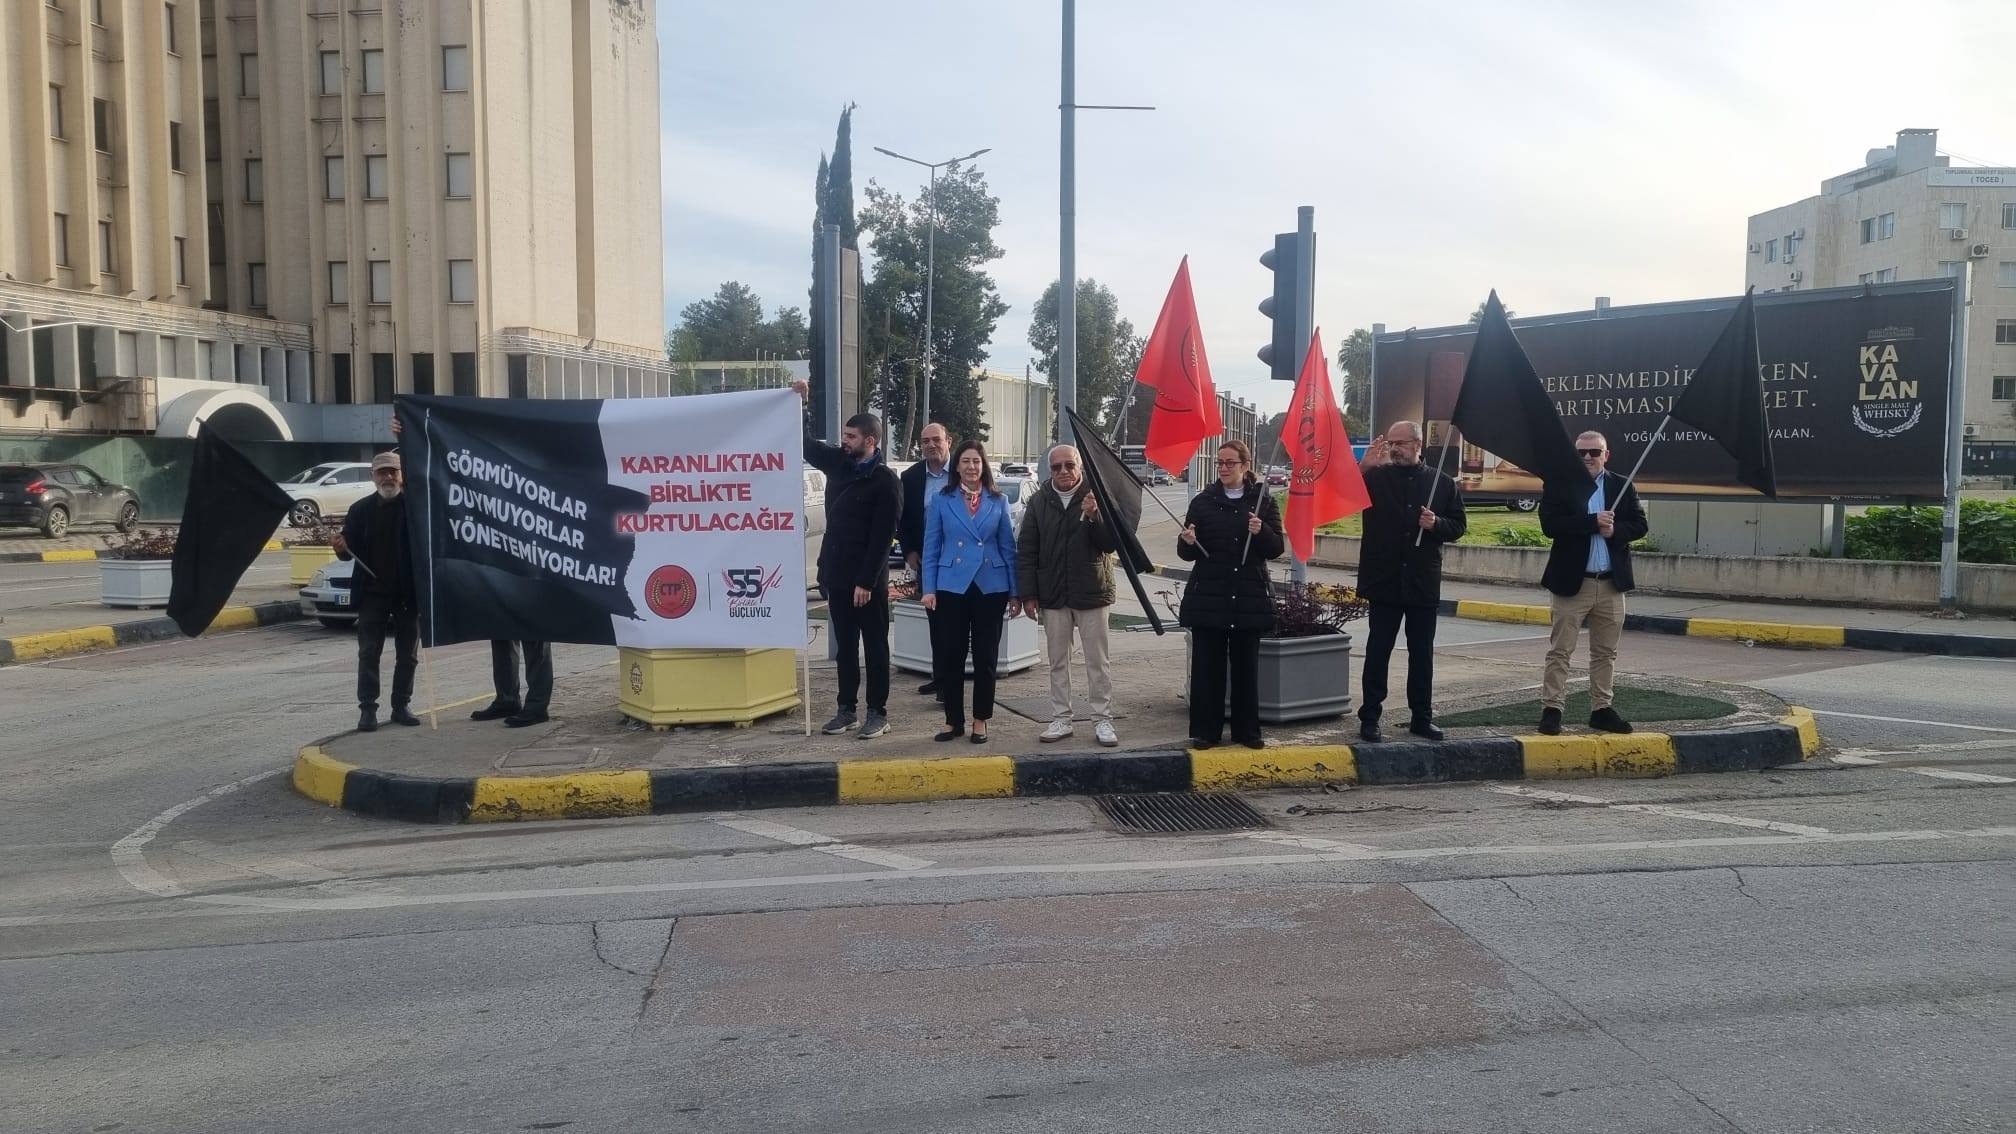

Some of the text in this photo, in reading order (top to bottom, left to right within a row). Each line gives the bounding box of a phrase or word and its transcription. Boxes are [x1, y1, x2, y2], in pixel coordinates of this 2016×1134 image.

[1860, 344, 1899, 364] KA
[1860, 363, 1898, 382] VA
[1859, 380, 1918, 401] LAN
[1555, 396, 1680, 420] ARTIŞMASI
[1863, 402, 1889, 410] SINGLE
[1863, 408, 1911, 419] WHISKY
[620, 452, 785, 474] KARANLIKTAN
[447, 448, 587, 521] GÖRMÜYORLAR
[650, 480, 752, 503] BİRLİKTE
[448, 483, 585, 551] DUYMUYORLAR
[616, 507, 795, 534] KURTULACAĞIZ
[449, 515, 617, 586] YÖNETEMİYORLAR!
[660, 583, 682, 596] CTP
[726, 569, 763, 599] 55
